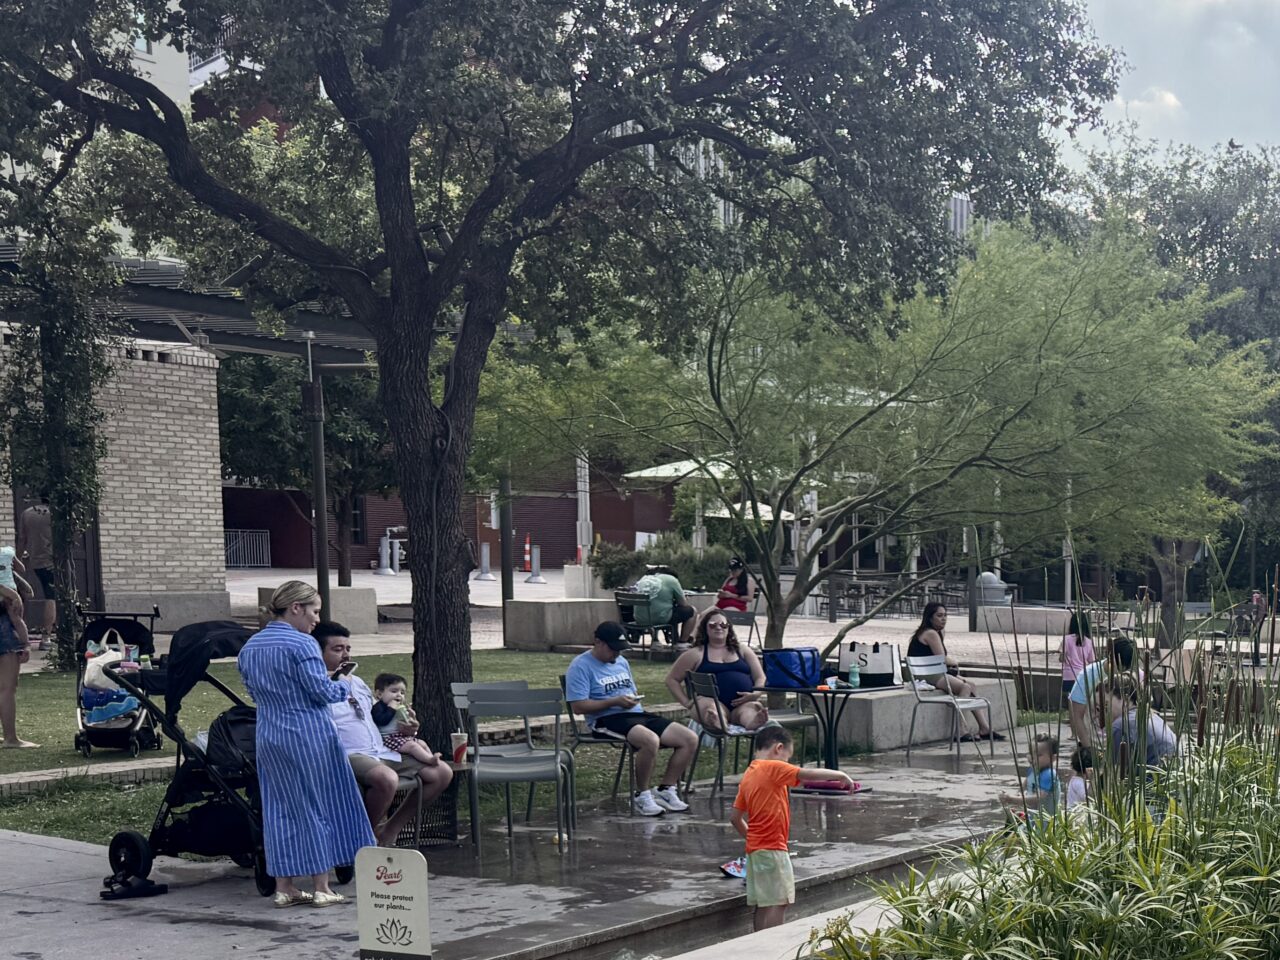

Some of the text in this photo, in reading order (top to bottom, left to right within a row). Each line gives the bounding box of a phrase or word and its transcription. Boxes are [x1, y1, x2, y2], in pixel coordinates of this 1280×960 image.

[858, 652, 868, 667] S
[376, 865, 403, 883] Pearl
[370, 891, 414, 903] Please protect
